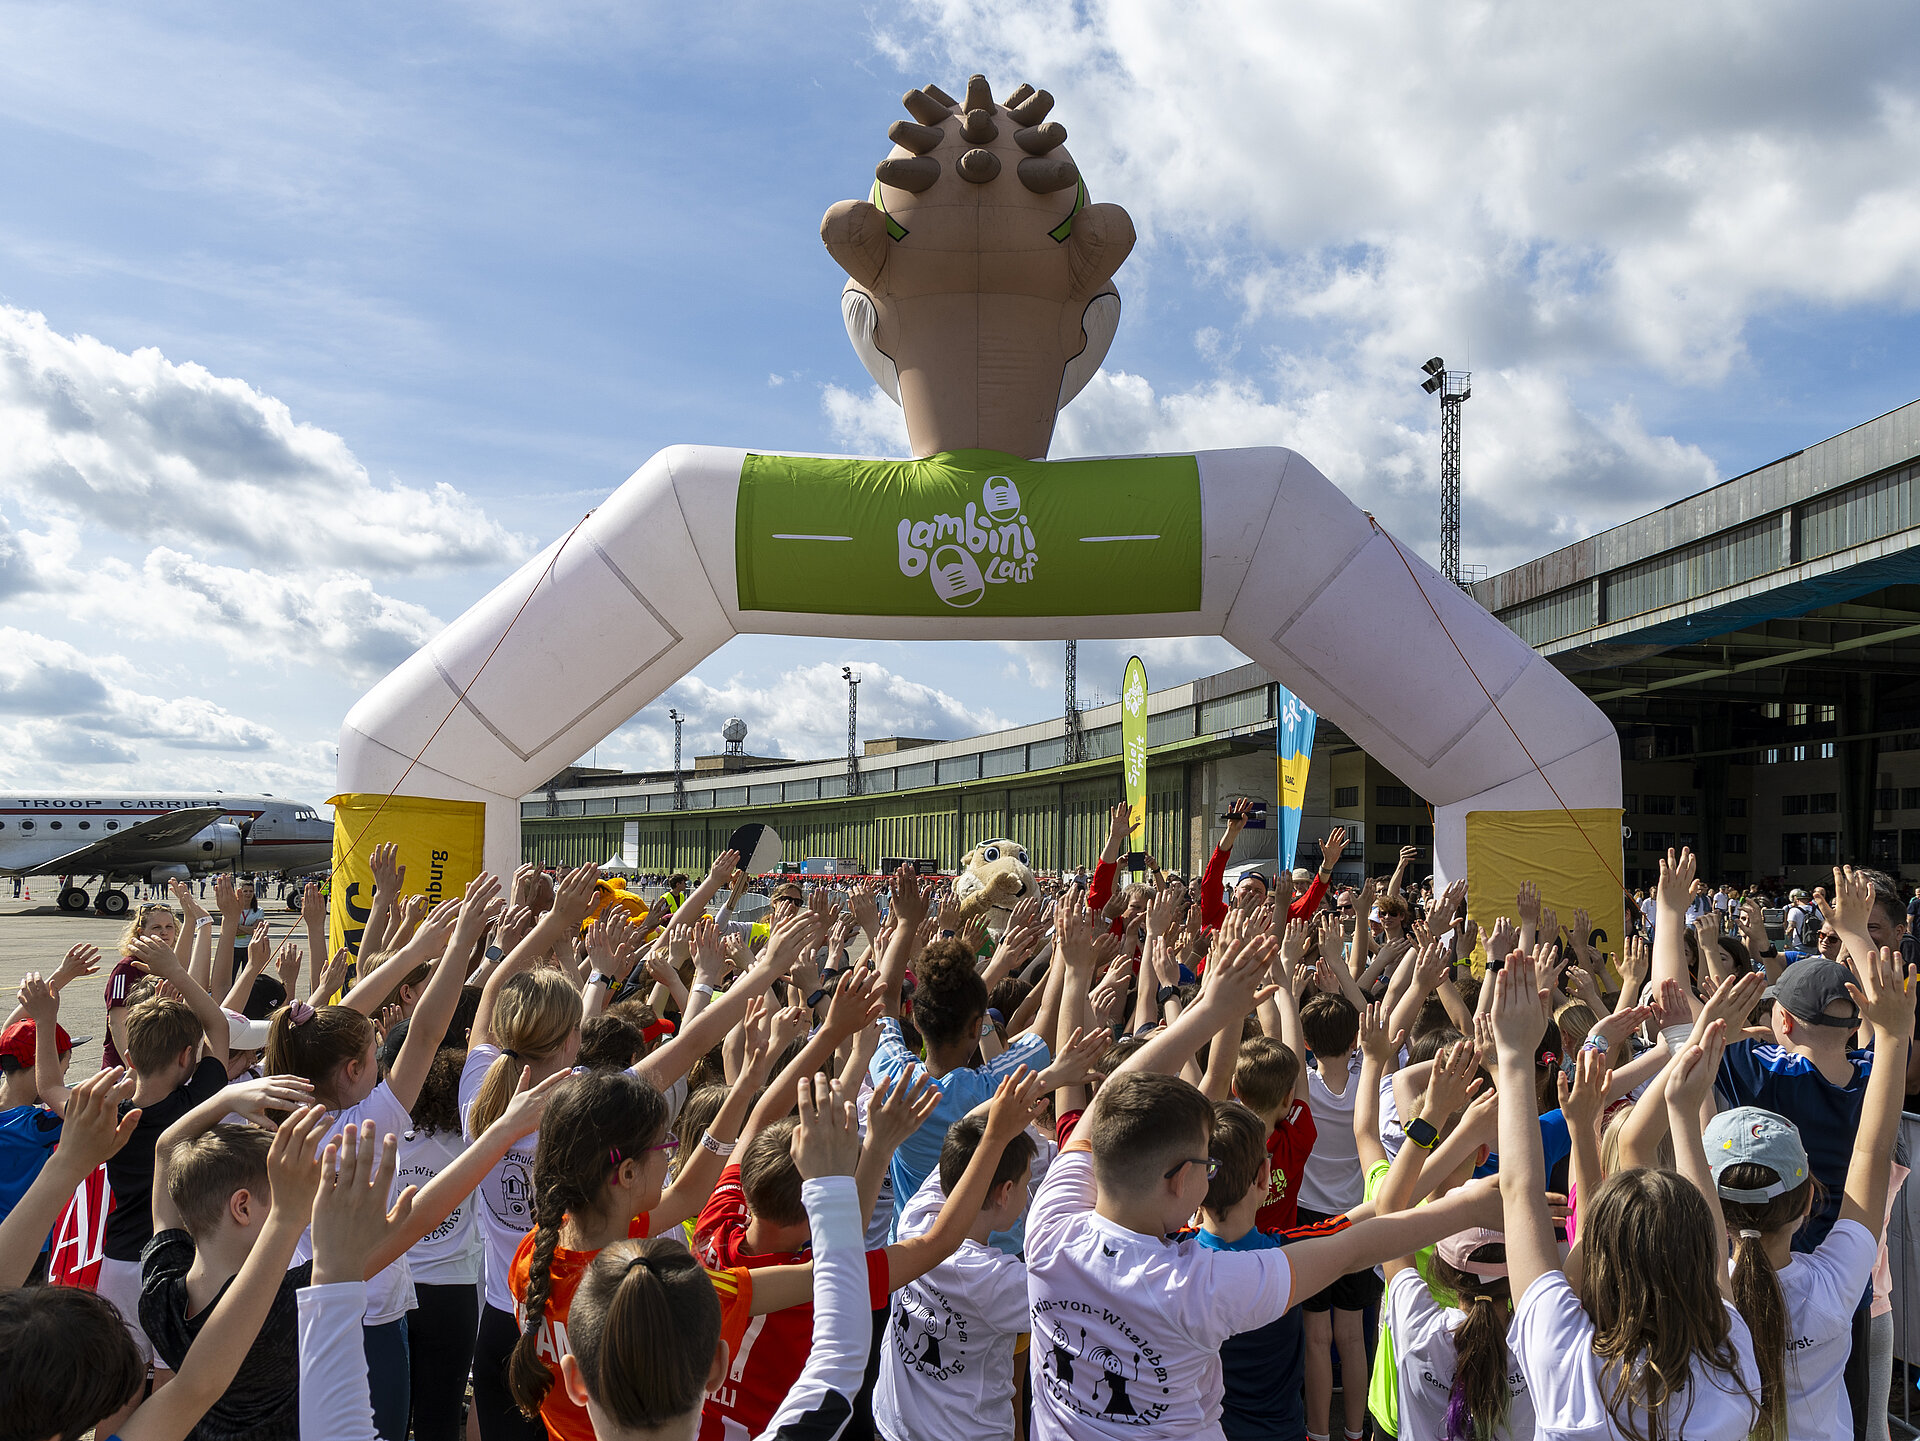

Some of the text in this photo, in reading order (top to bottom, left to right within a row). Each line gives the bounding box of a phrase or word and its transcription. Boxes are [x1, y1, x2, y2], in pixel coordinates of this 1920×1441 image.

[897, 501, 1036, 578] bambini
[1128, 741, 1137, 787] Spiel
[1136, 734, 1145, 777] mit
[18, 799, 102, 809] TROOP
